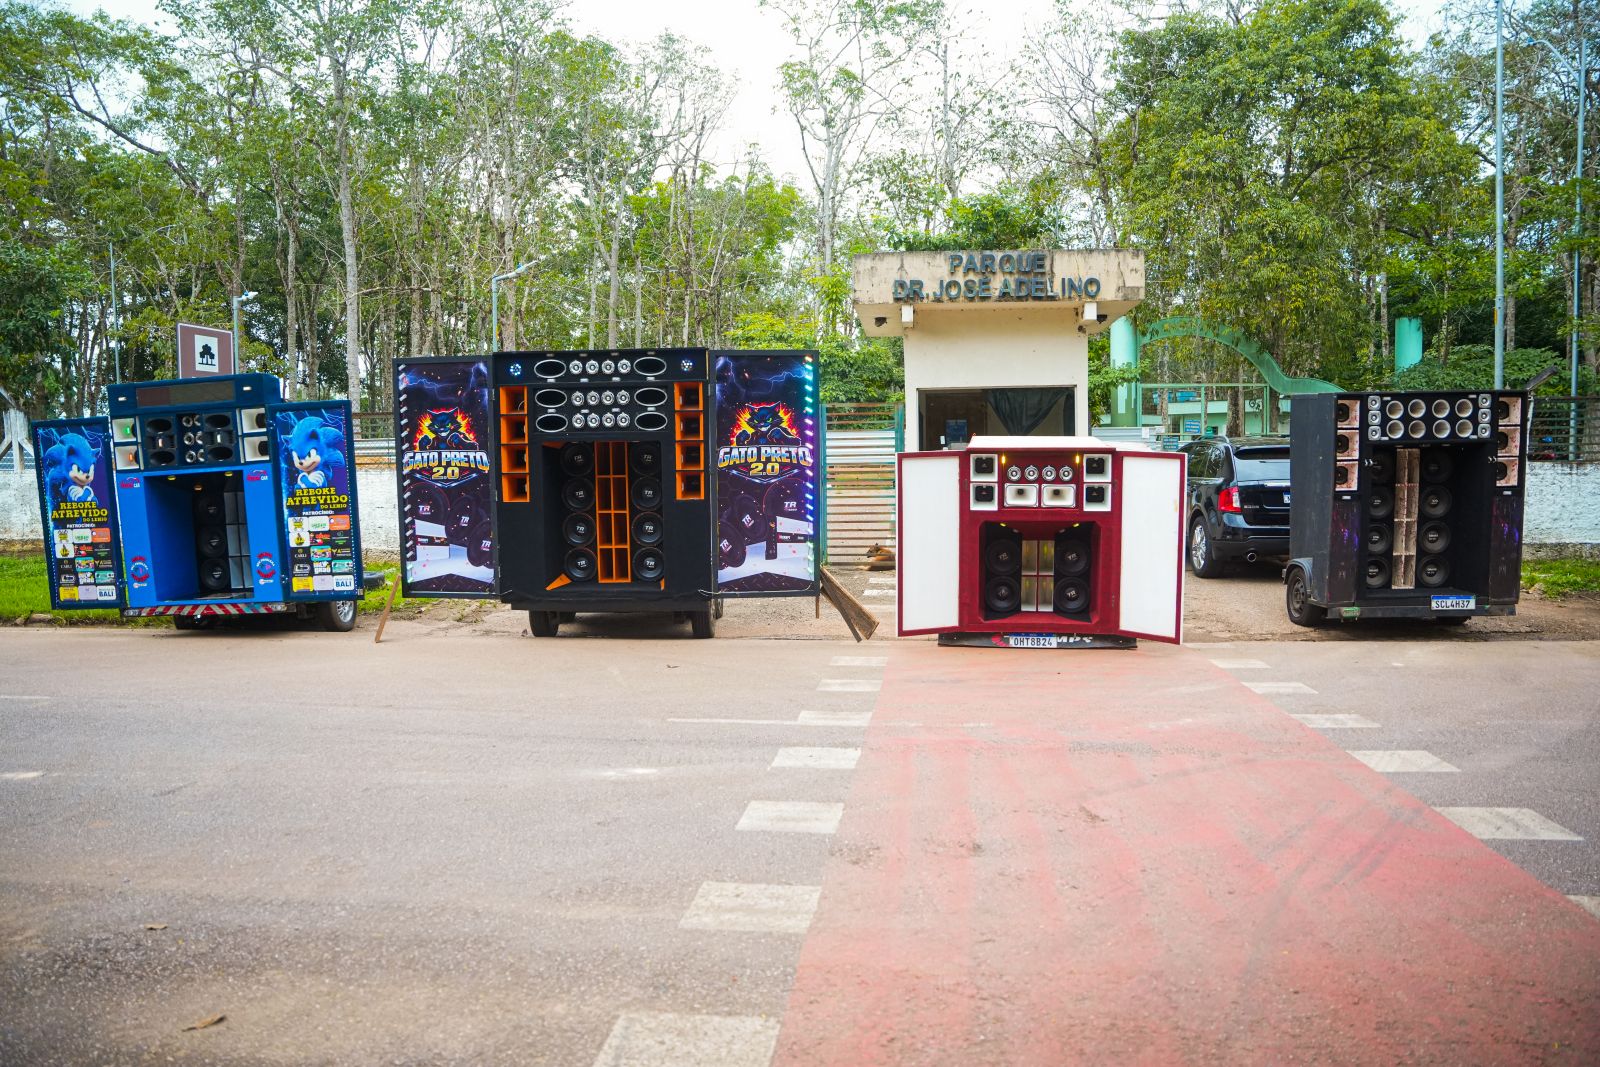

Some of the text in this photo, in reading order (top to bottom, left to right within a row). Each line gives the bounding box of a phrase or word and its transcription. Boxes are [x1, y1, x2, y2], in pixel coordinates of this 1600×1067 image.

[950, 253, 1047, 273] PARQUE
[892, 279, 930, 299] DR.
[1000, 277, 1101, 298] ADELINO
[403, 450, 490, 471] GATO PRETO
[717, 446, 813, 468] GATO PRETO
[431, 466, 460, 480] 2.0
[749, 462, 780, 476] 2.0
[296, 487, 336, 496] REBOKE
[60, 501, 97, 510] REBOKE
[287, 495, 348, 506] ATREVIDO
[51, 508, 108, 519] ATREVIDO
[461, 516, 470, 524] TR
[482, 540, 492, 548] TR
[1435, 600, 1471, 609] SCL4H37
